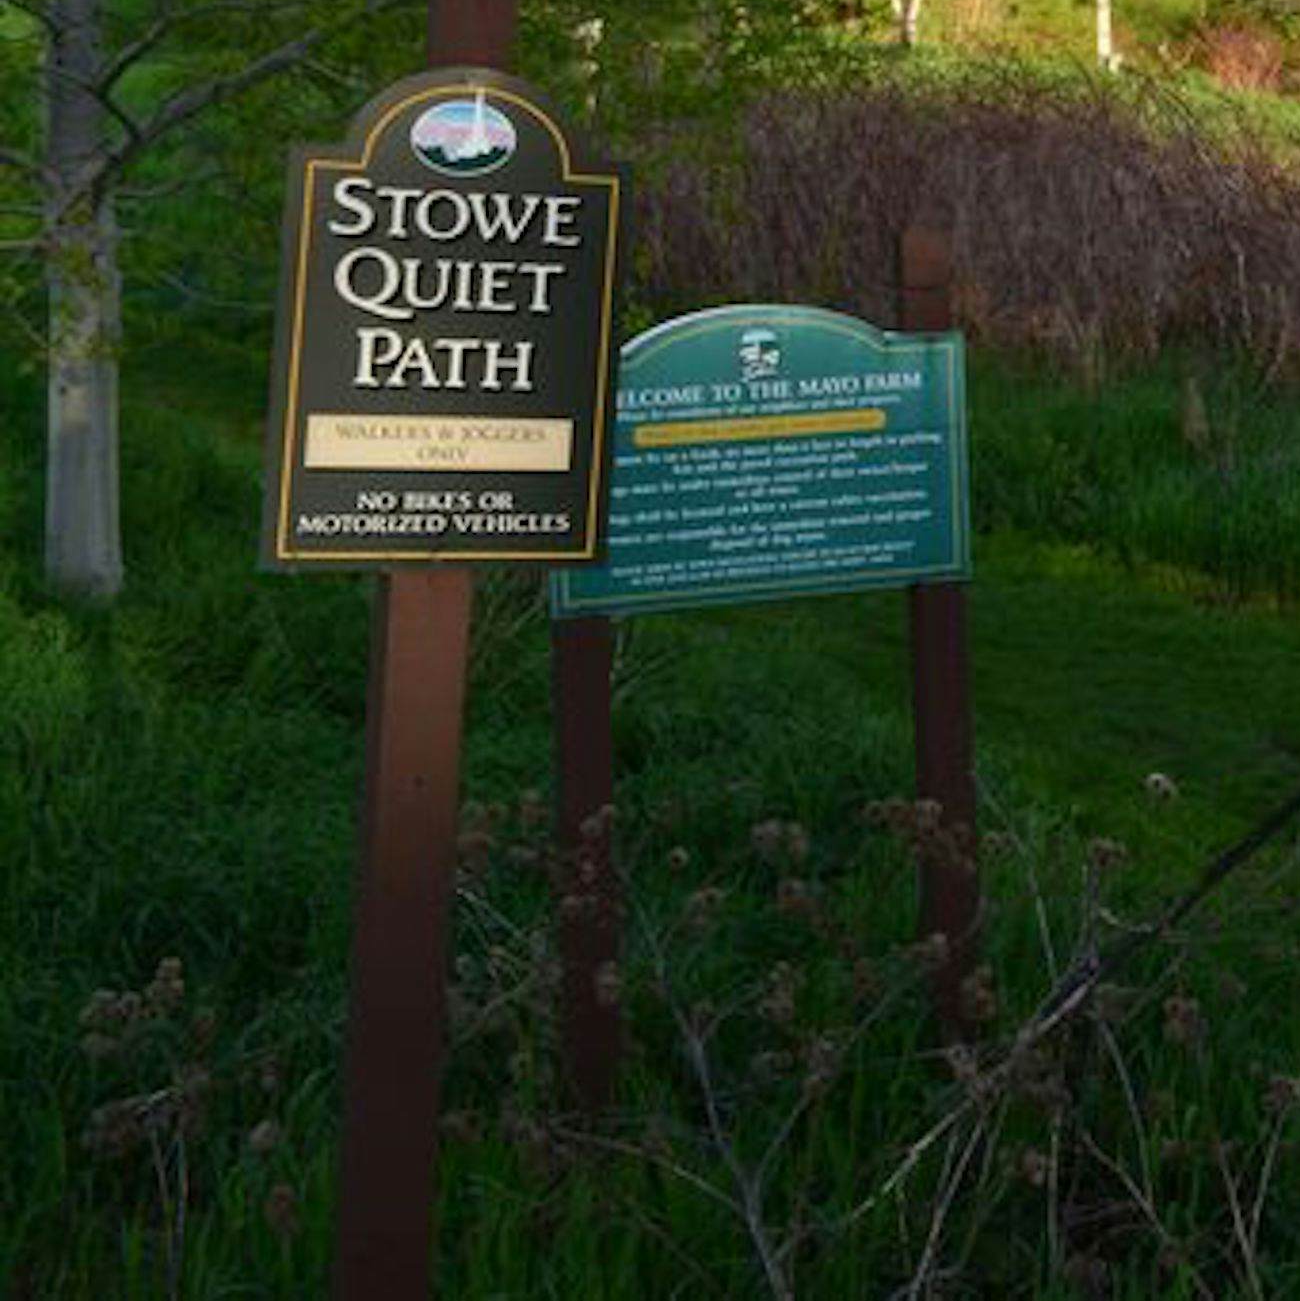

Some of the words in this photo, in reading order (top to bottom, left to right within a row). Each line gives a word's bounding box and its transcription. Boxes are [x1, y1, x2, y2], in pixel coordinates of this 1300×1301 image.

[328, 177, 583, 247] STOWE
[333, 246, 567, 320] QUIET
[353, 326, 535, 392] PATH
[616, 384, 704, 410] ELCOME
[711, 384, 742, 403] TO
[749, 380, 791, 400] THE
[799, 376, 860, 398] MAYO
[864, 371, 922, 393] FARM
[334, 423, 431, 441] WALKERS
[459, 425, 547, 442] JOGGERS
[416, 445, 471, 462] ONLY
[356, 490, 398, 512] NO
[402, 490, 474, 512] BIKES
[478, 490, 514, 512] OR
[297, 513, 448, 534] MOTORIZED
[452, 513, 571, 534] VEHICLES
